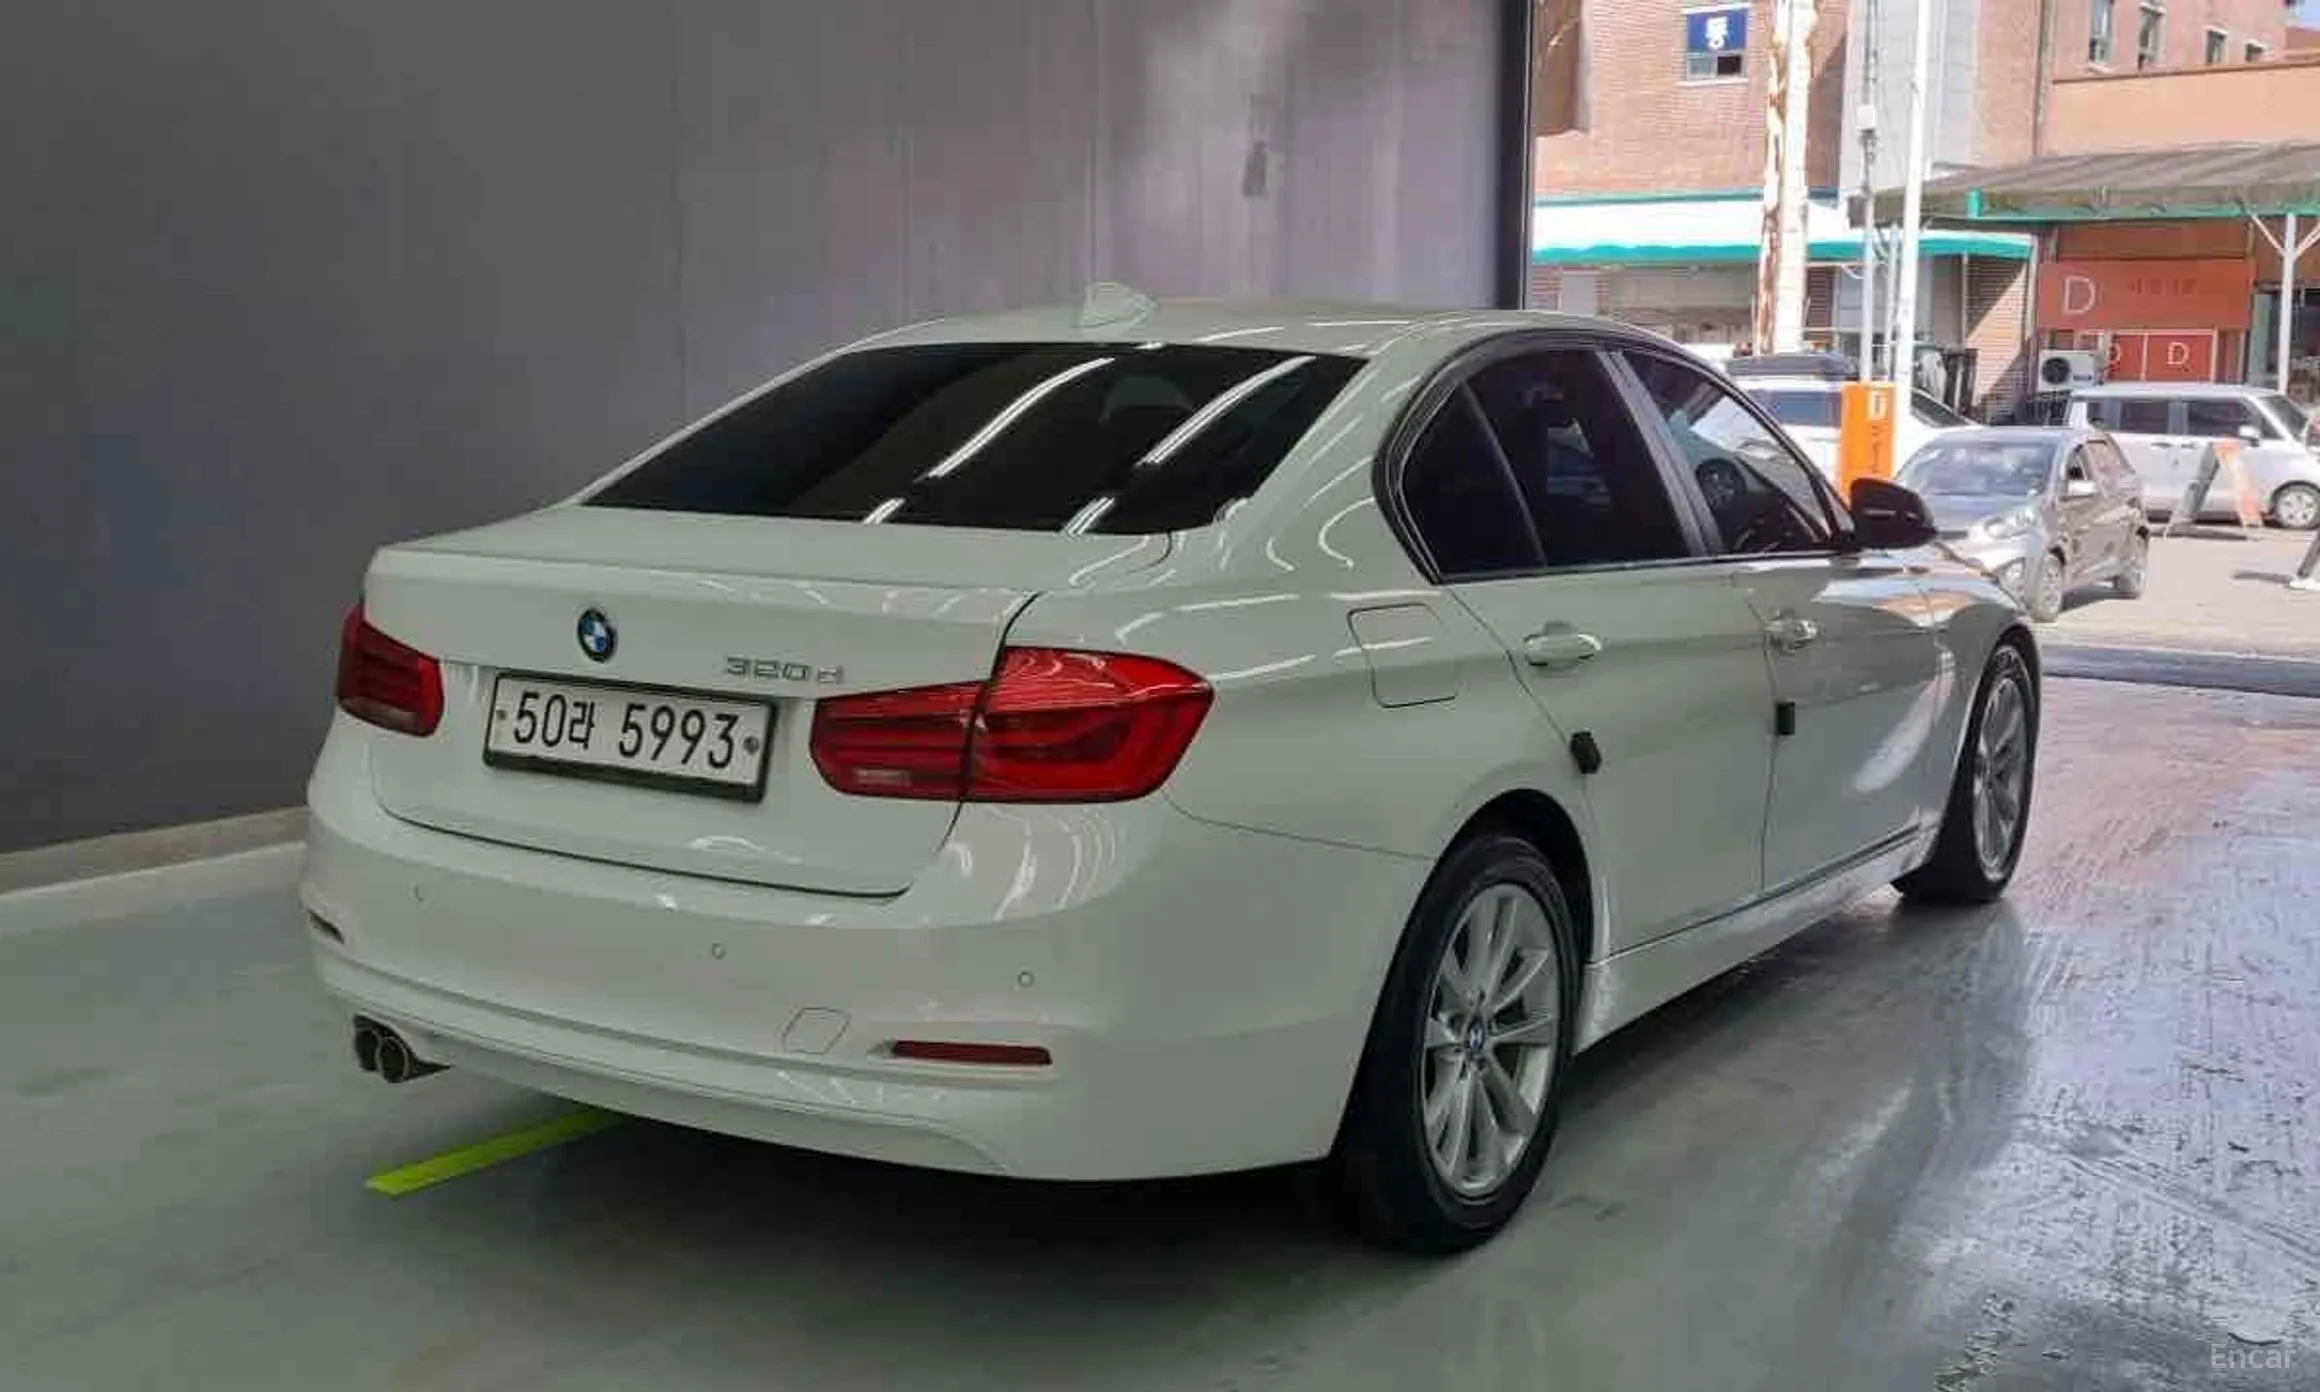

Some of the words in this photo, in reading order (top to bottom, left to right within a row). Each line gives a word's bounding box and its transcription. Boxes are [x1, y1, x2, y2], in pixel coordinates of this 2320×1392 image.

[2064, 275, 2096, 315] D
[513, 690, 596, 750] 50라
[618, 702, 740, 769] 5993
